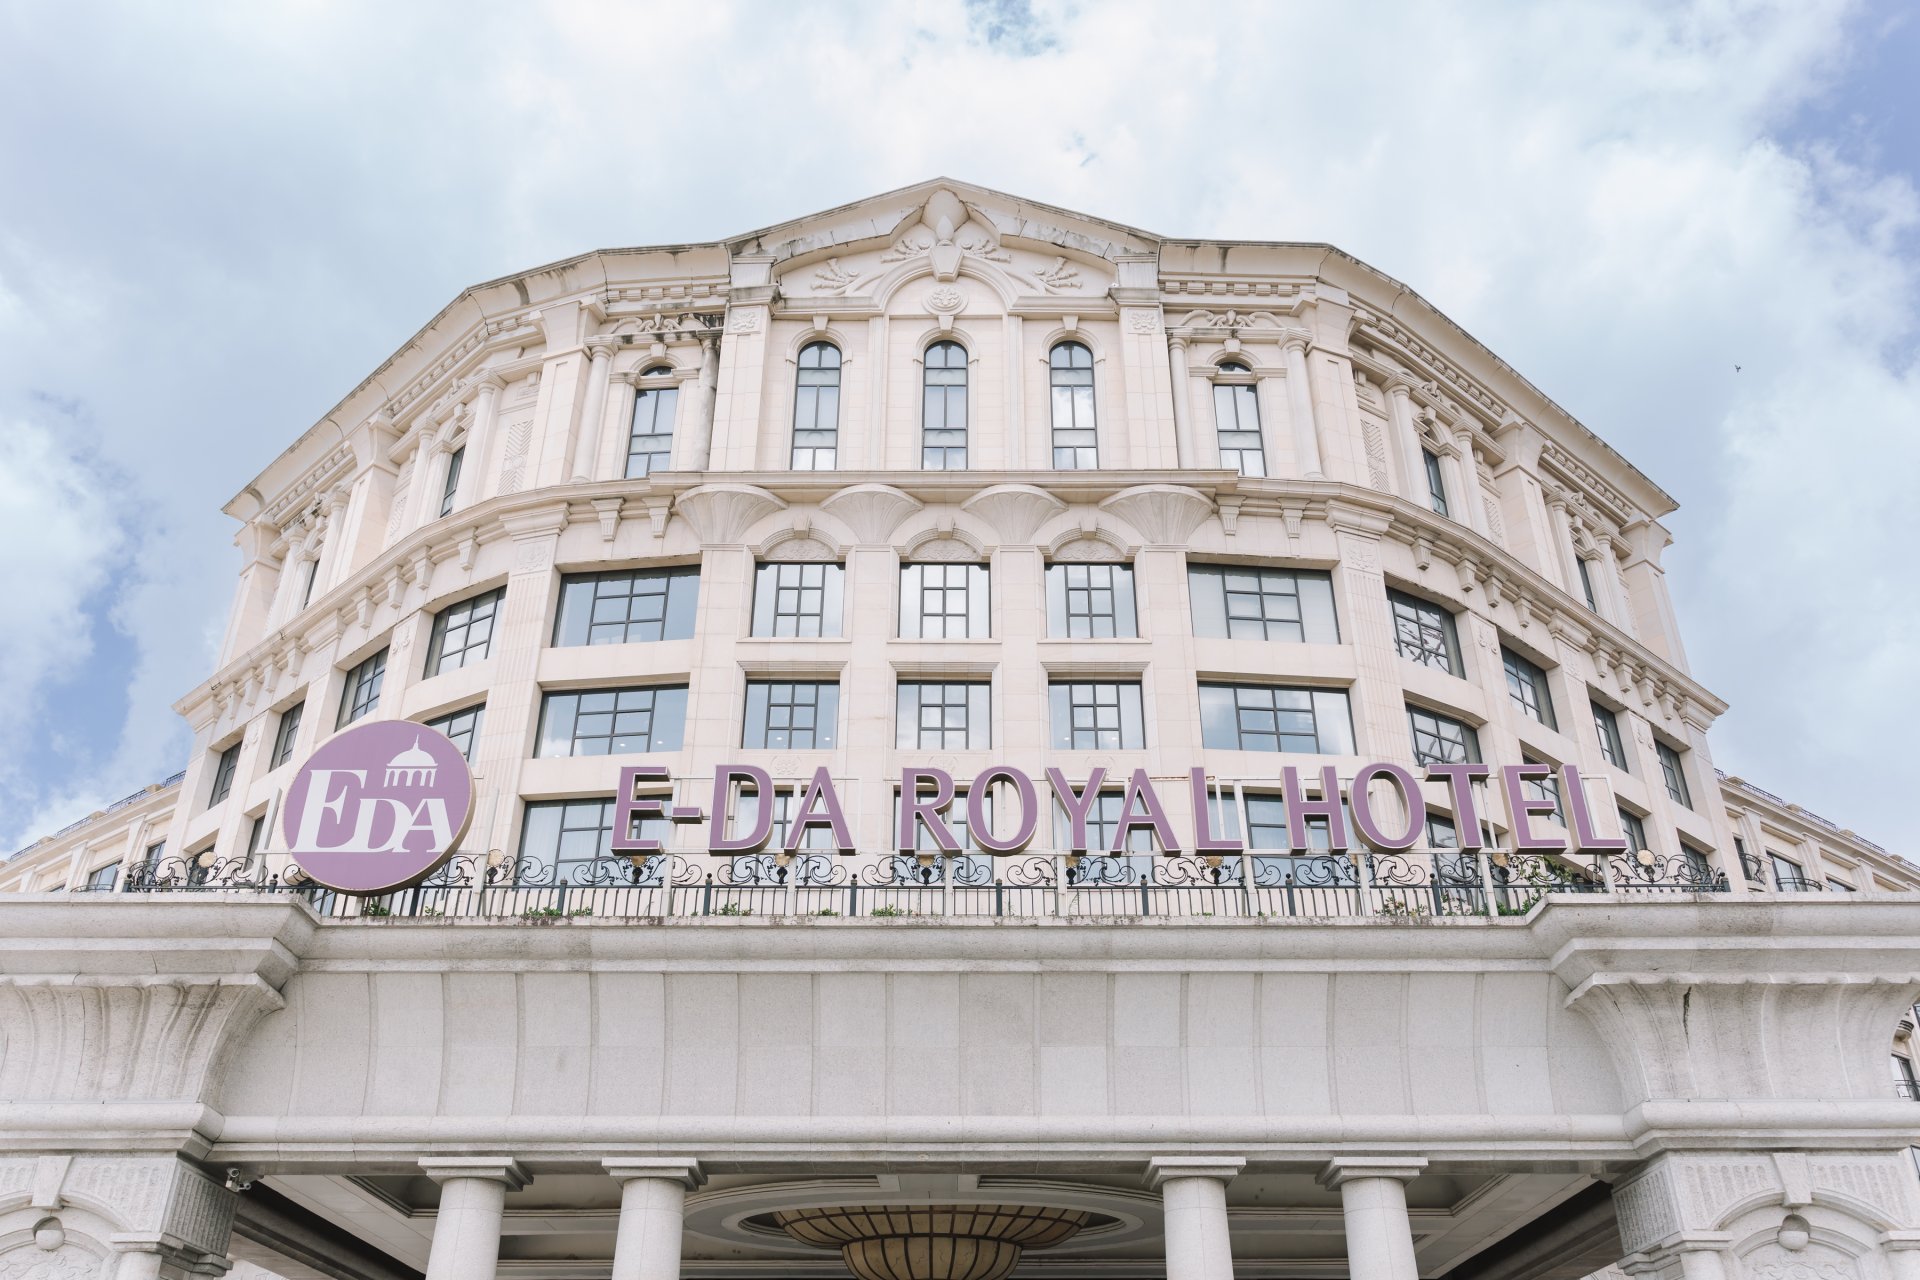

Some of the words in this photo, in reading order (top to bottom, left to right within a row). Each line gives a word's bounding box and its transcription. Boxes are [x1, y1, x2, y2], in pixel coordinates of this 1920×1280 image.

[292, 768, 454, 853] EDA
[611, 765, 856, 856] E-DA
[899, 766, 1244, 856] ROYAL
[1281, 763, 1627, 856] HOTEL
